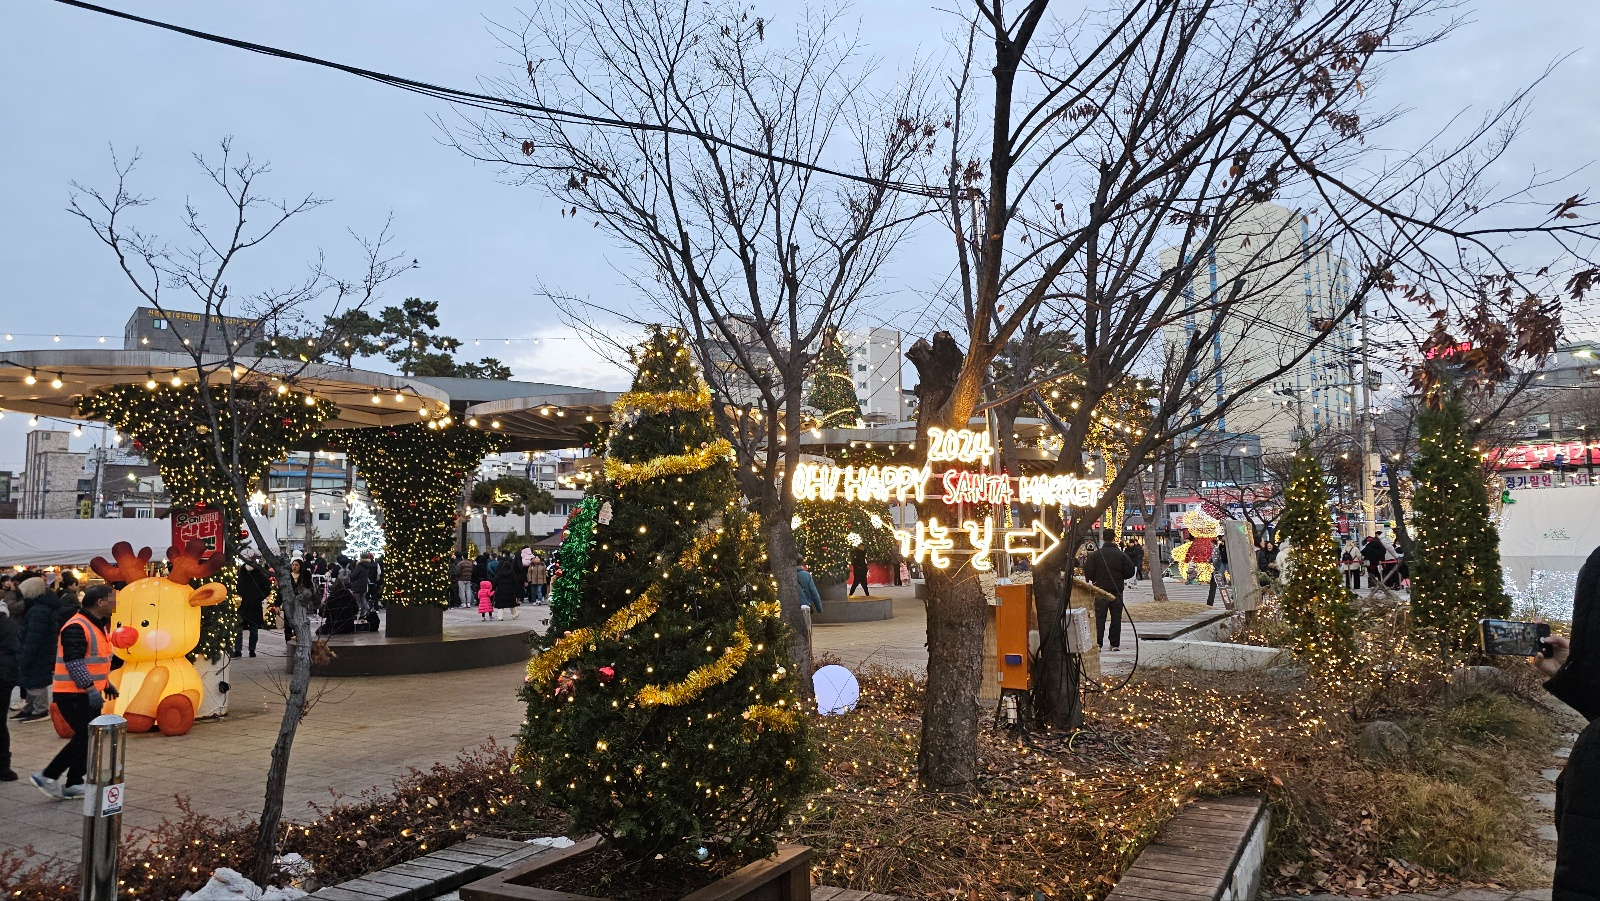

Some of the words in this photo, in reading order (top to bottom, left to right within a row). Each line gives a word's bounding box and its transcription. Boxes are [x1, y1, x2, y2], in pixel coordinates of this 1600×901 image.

[927, 427, 994, 466] 2024
[844, 464, 931, 503] HAPPY
[942, 469, 1014, 504] SANTA
[1019, 473, 1104, 507] MARKET
[895, 517, 953, 569] 가는
[963, 516, 994, 571] 길
